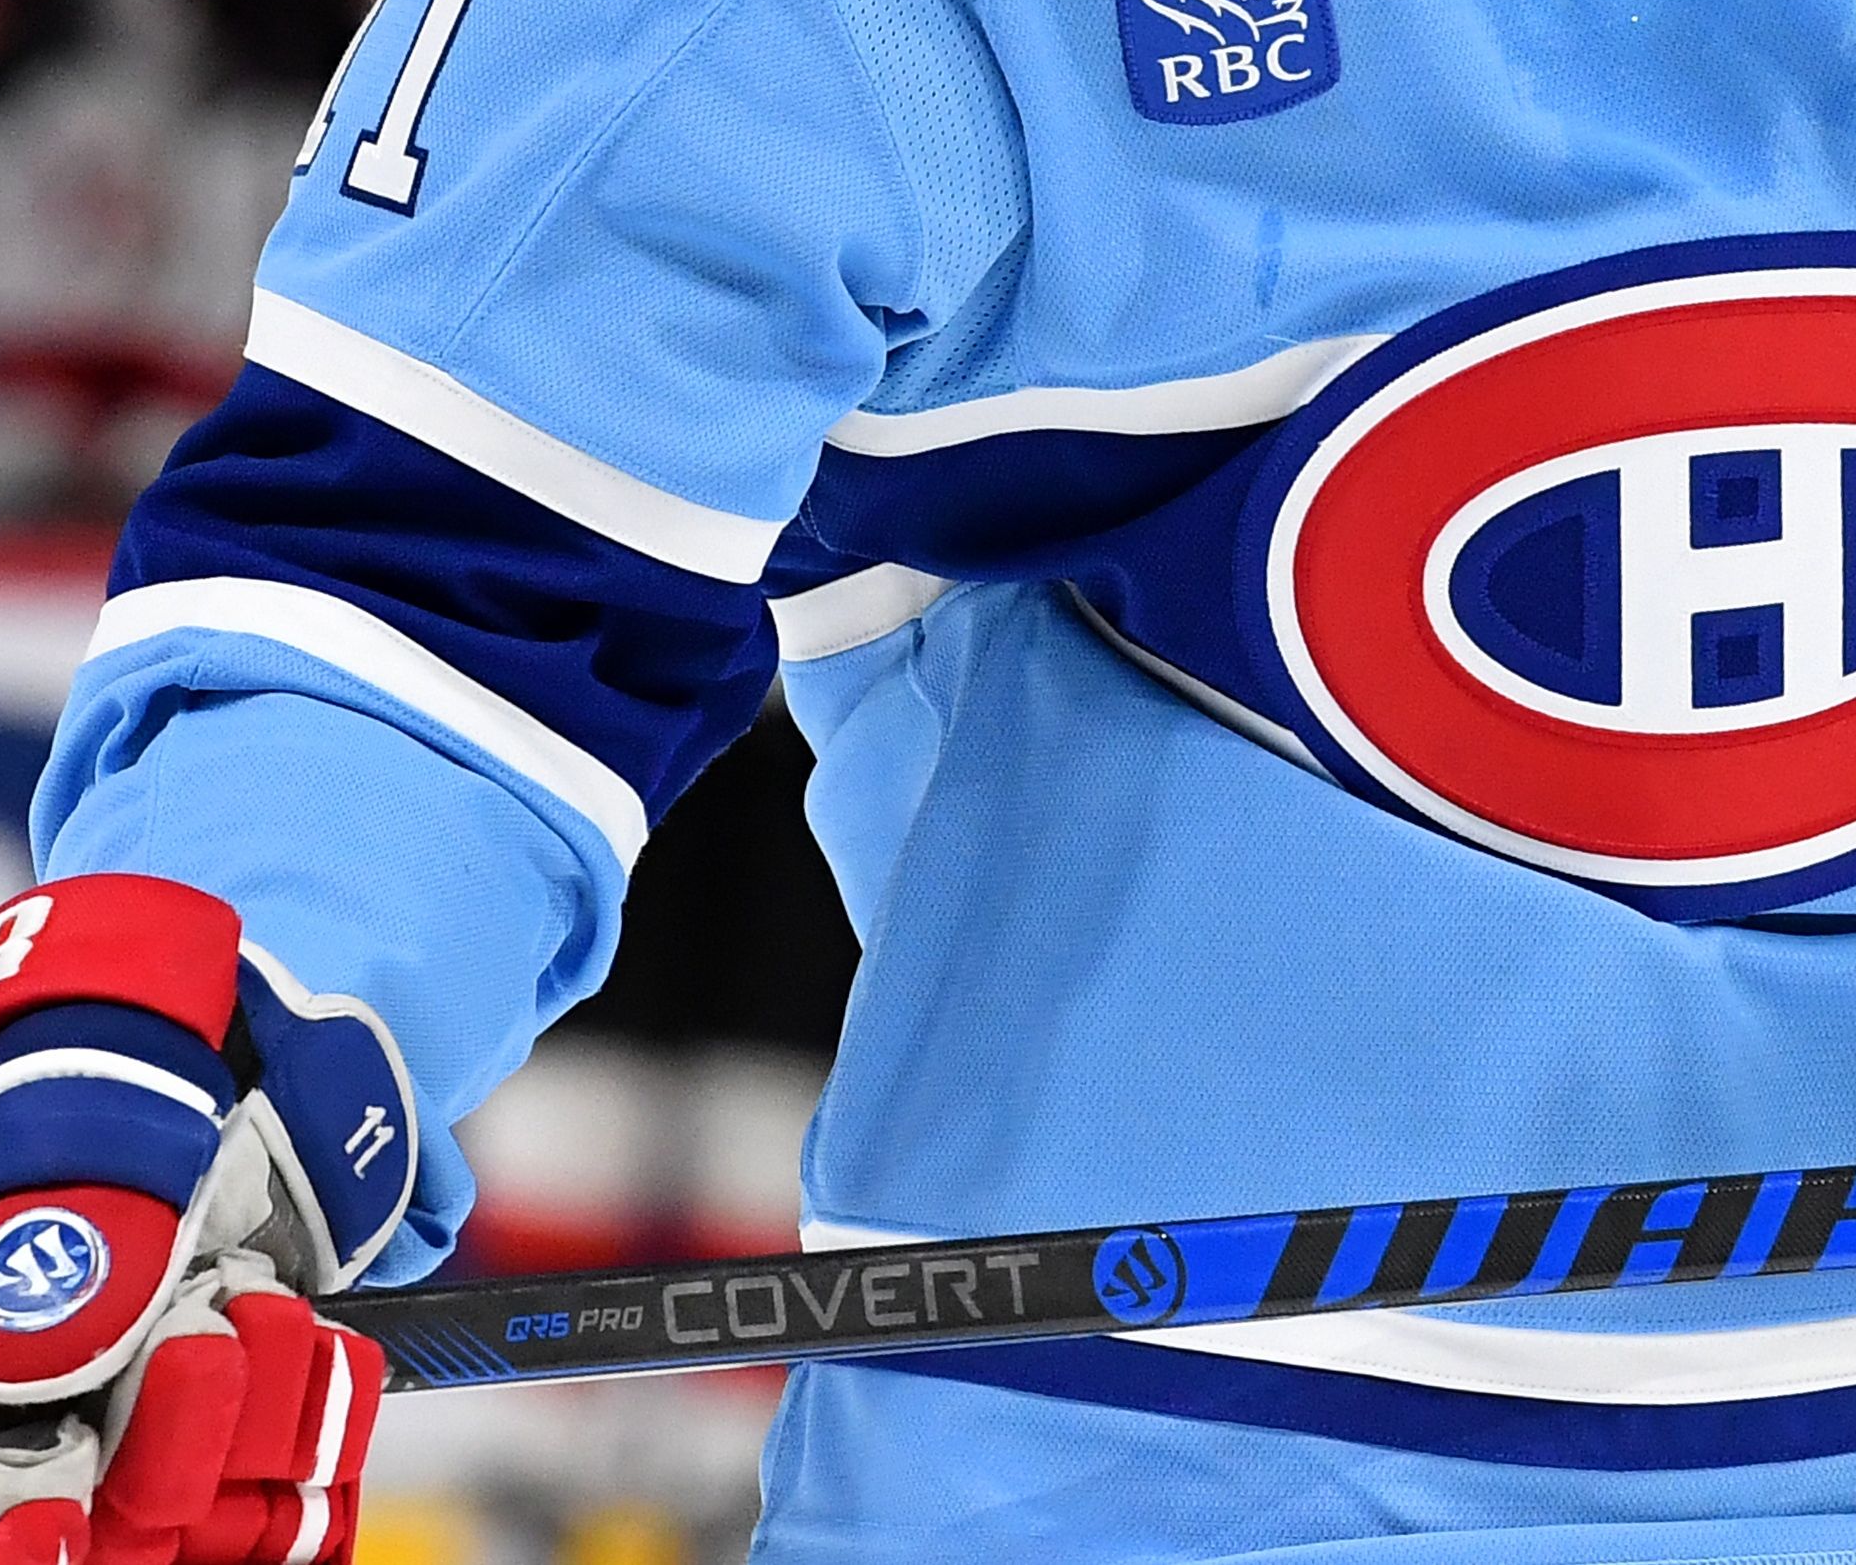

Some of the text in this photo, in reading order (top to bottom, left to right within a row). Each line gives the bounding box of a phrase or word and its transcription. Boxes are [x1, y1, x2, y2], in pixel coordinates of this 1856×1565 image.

[1156, 33, 1312, 103] RBC
[344, 1105, 396, 1180] 11
[577, 1306, 644, 1334] PRO
[662, 1252, 1041, 1344] COVERT
